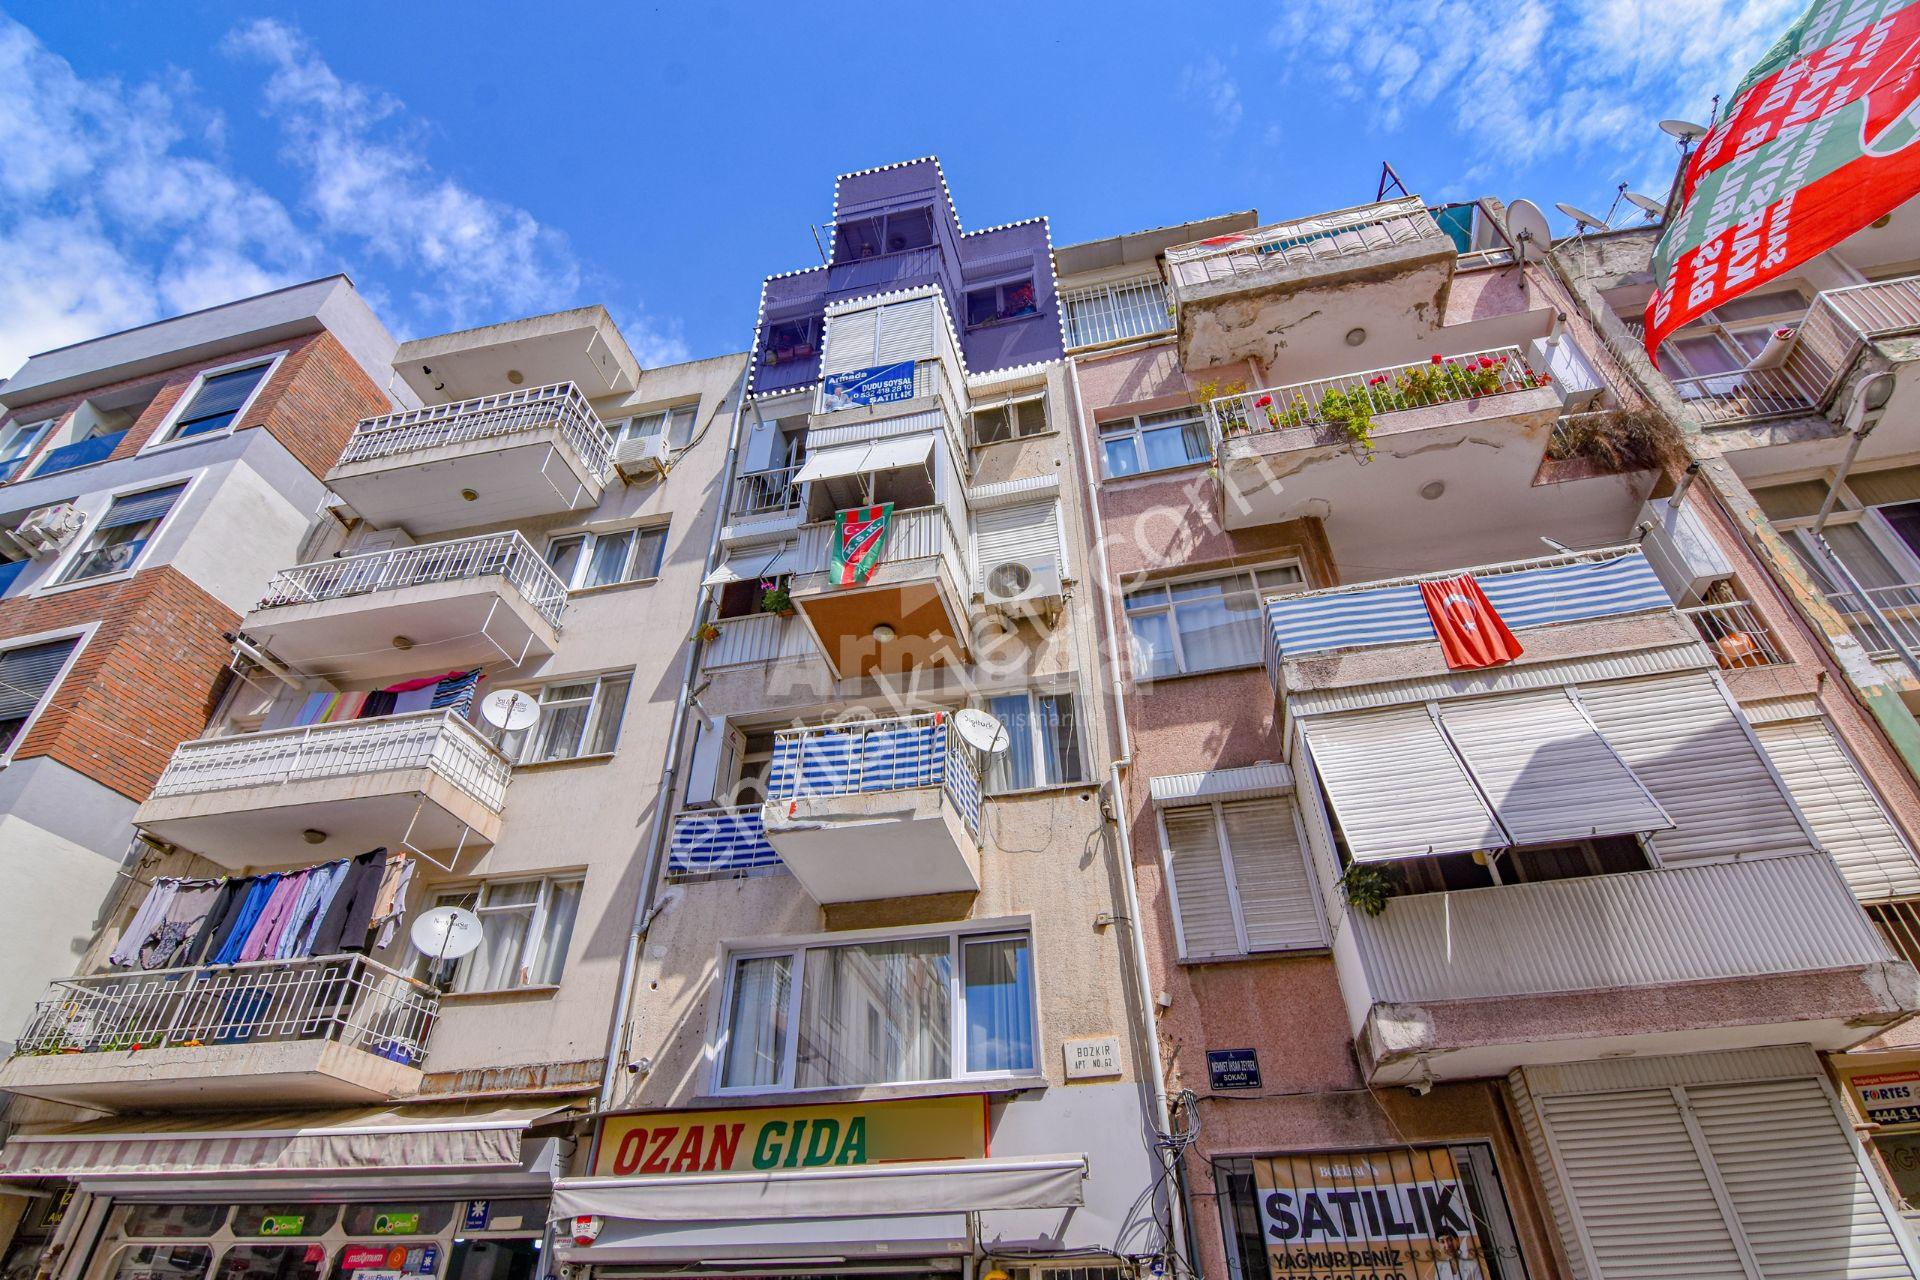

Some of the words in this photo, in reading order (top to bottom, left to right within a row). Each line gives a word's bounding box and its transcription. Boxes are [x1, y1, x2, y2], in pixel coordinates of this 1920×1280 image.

[828, 371, 867, 385] Armada
[862, 382, 883, 392] DUDU
[883, 377, 912, 388] SOYSAL
[869, 390, 912, 403] SATILIK
[1077, 1045, 1111, 1058] BOZKIR
[1862, 1086, 1910, 1102] FORTES
[612, 1123, 745, 1176] OZAN
[752, 1116, 867, 1170] GIDA
[1266, 1184, 1471, 1240] SATILIK
[1272, 1248, 1347, 1270] YAĞMUR
[1347, 1246, 1403, 1268] DENİZ
